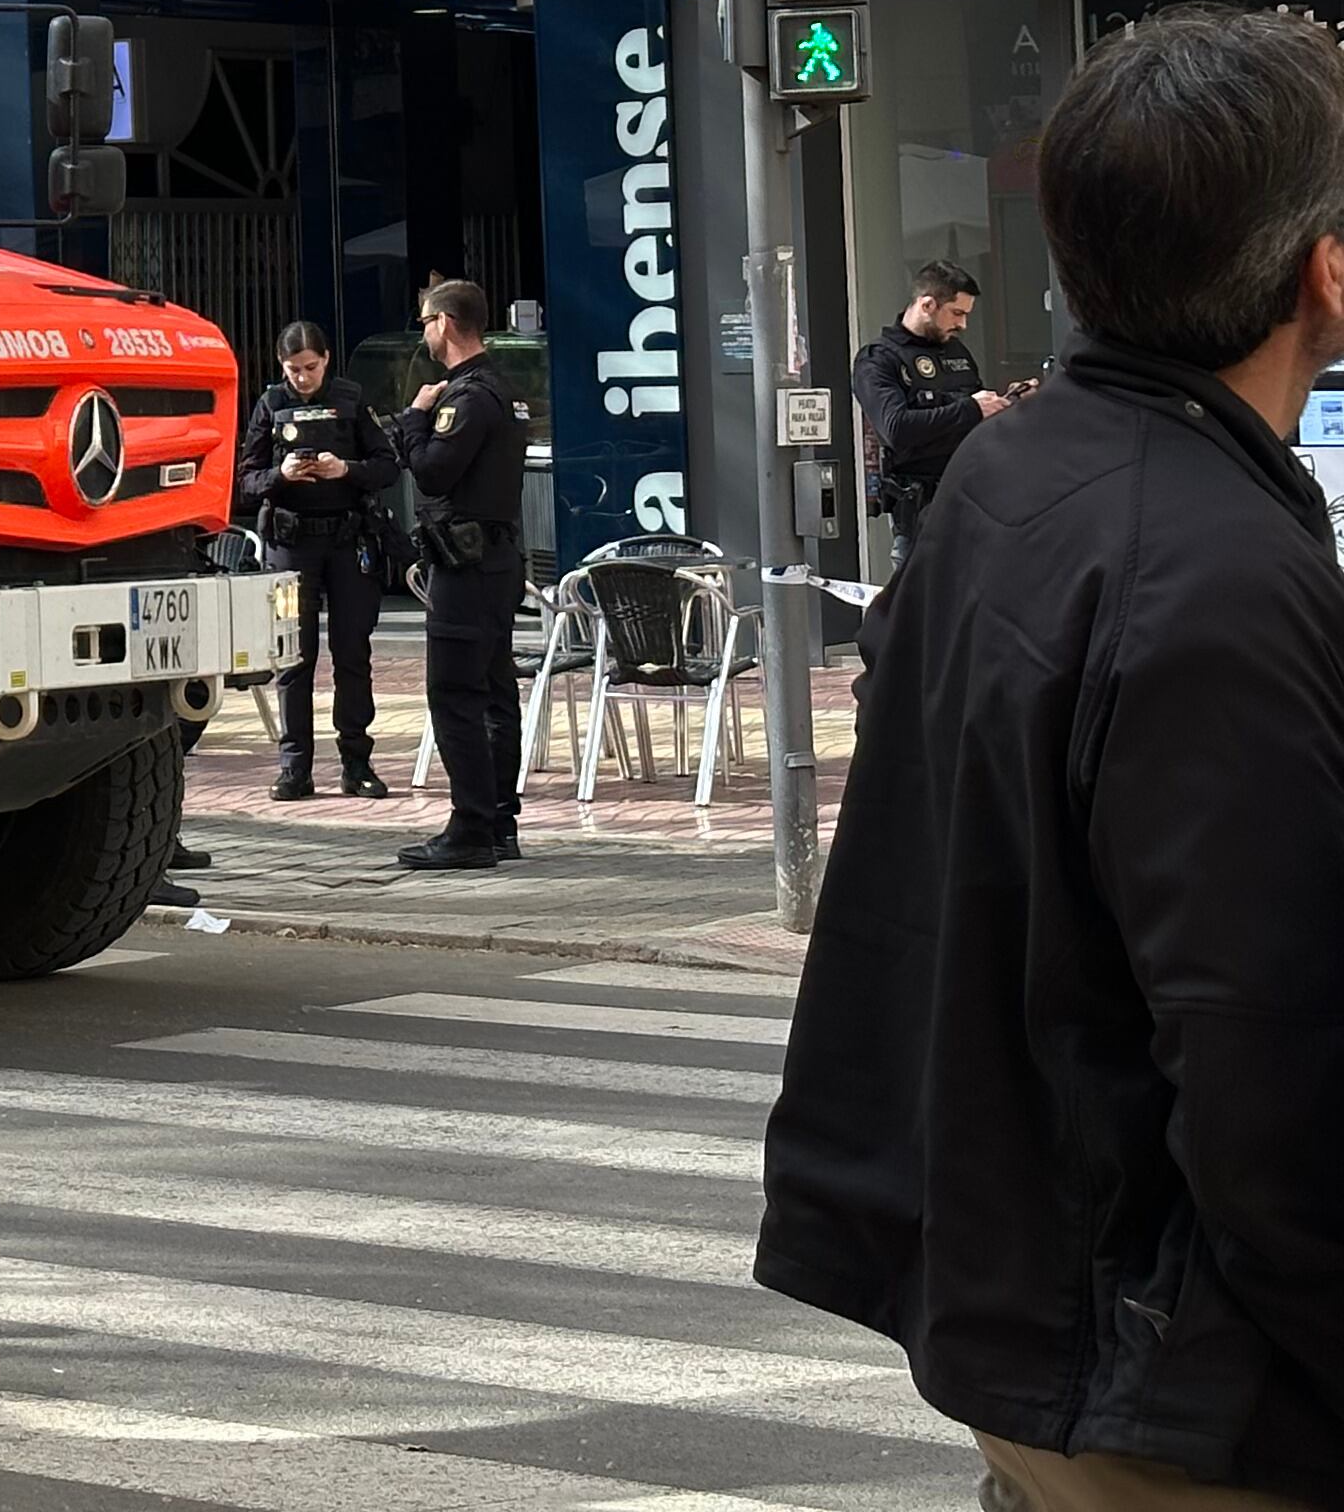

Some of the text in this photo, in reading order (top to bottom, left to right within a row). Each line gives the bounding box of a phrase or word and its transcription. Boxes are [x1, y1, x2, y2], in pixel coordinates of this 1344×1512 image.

[597, 26, 681, 418] ibense
[103, 326, 174, 359] 28533
[141, 589, 190, 624] 4760
[145, 635, 182, 670] KWK
